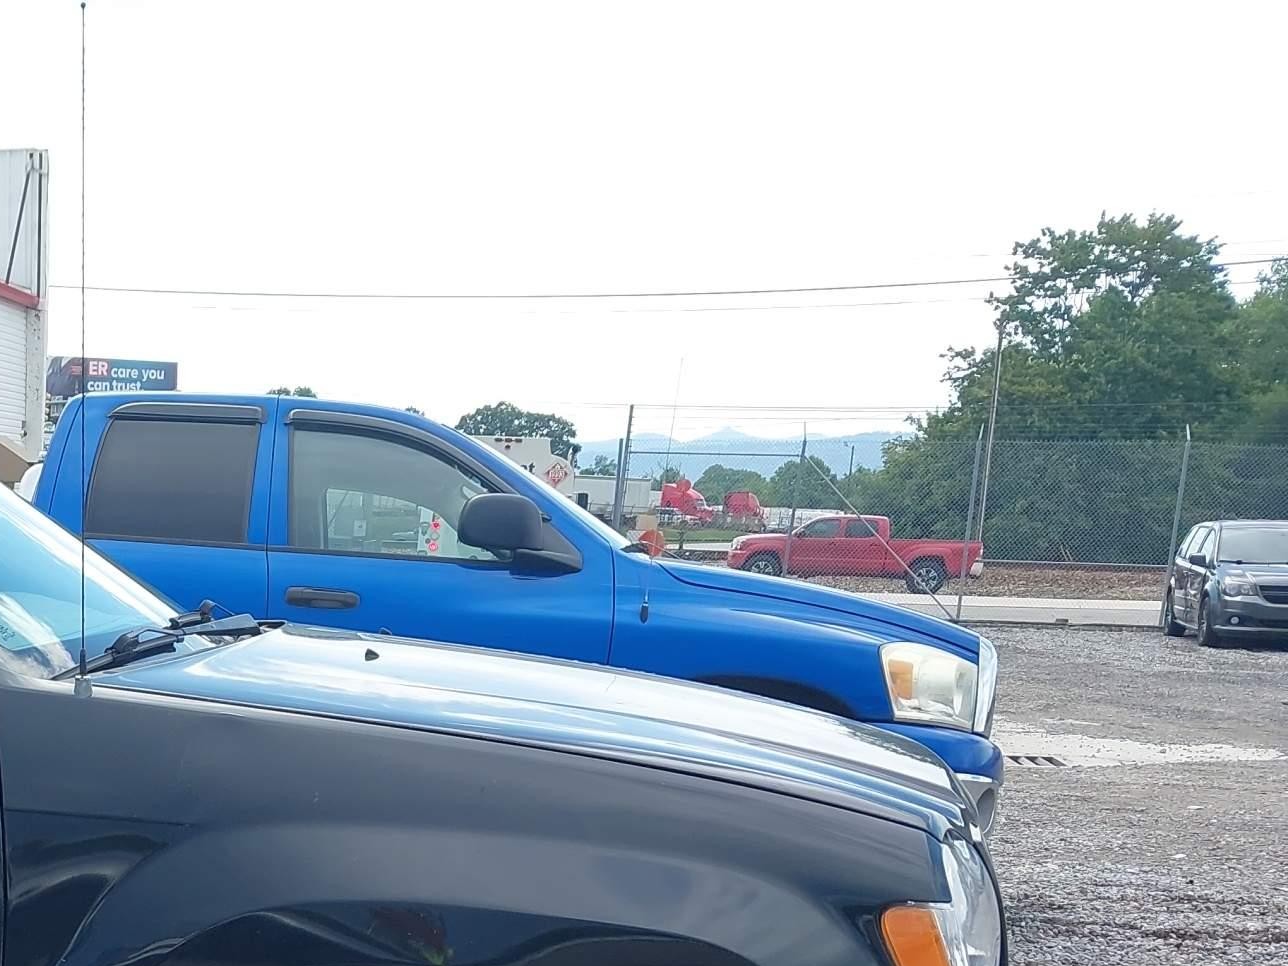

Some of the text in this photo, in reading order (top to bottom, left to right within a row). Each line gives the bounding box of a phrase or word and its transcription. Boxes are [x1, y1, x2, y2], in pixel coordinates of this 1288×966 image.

[89, 361, 108, 376] ER
[111, 367, 139, 379] care
[142, 369, 165, 382] you
[87, 380, 110, 391] can
